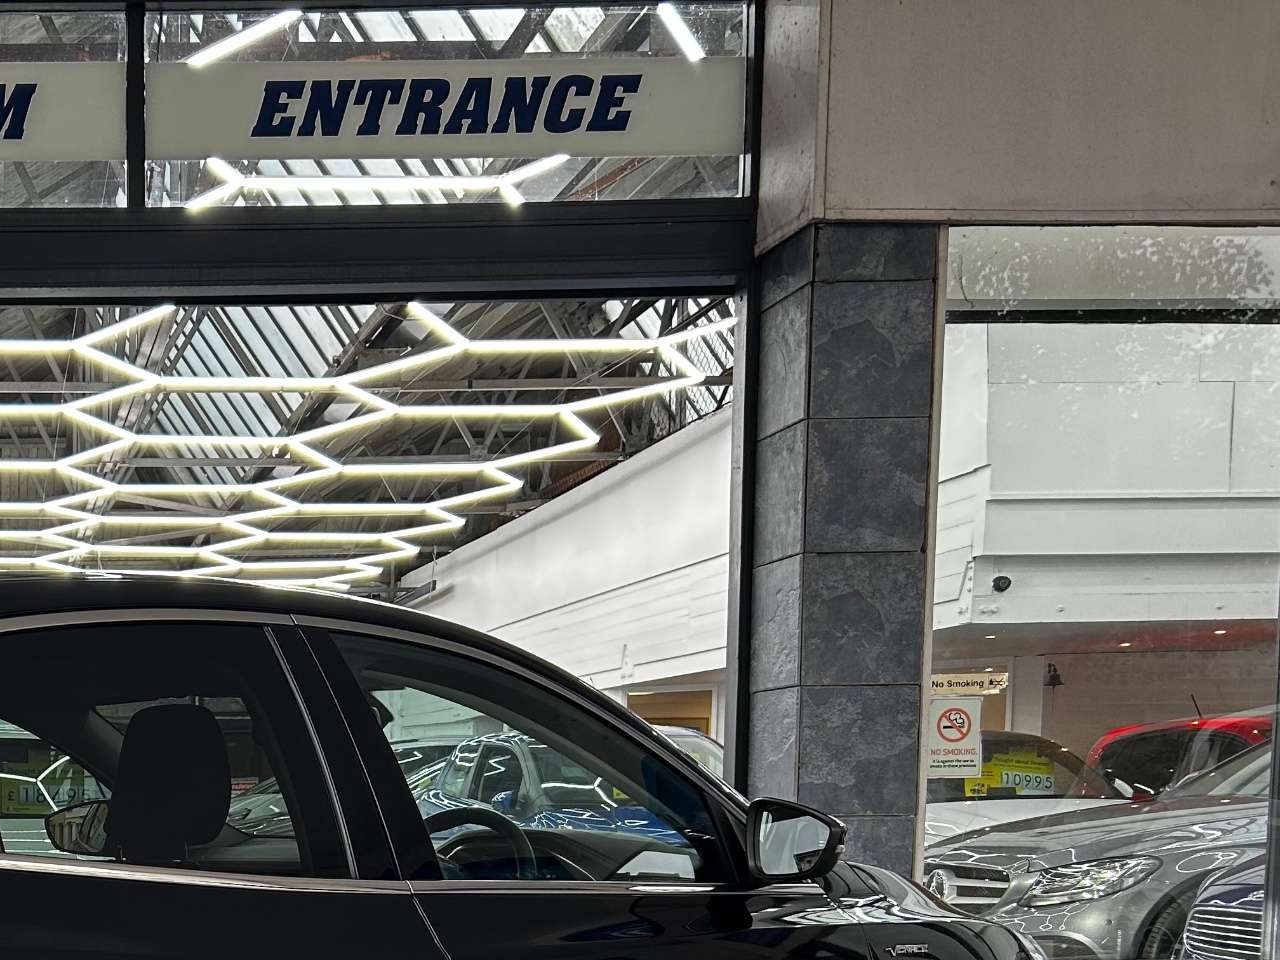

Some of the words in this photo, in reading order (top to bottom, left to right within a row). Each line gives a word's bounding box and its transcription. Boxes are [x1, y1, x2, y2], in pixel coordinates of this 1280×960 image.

[250, 74, 643, 137] ENTRANCE
[931, 680, 944, 688] No
[946, 679, 984, 689] Smoking
[930, 748, 941, 756] NO
[1004, 772, 1053, 790] 10995
